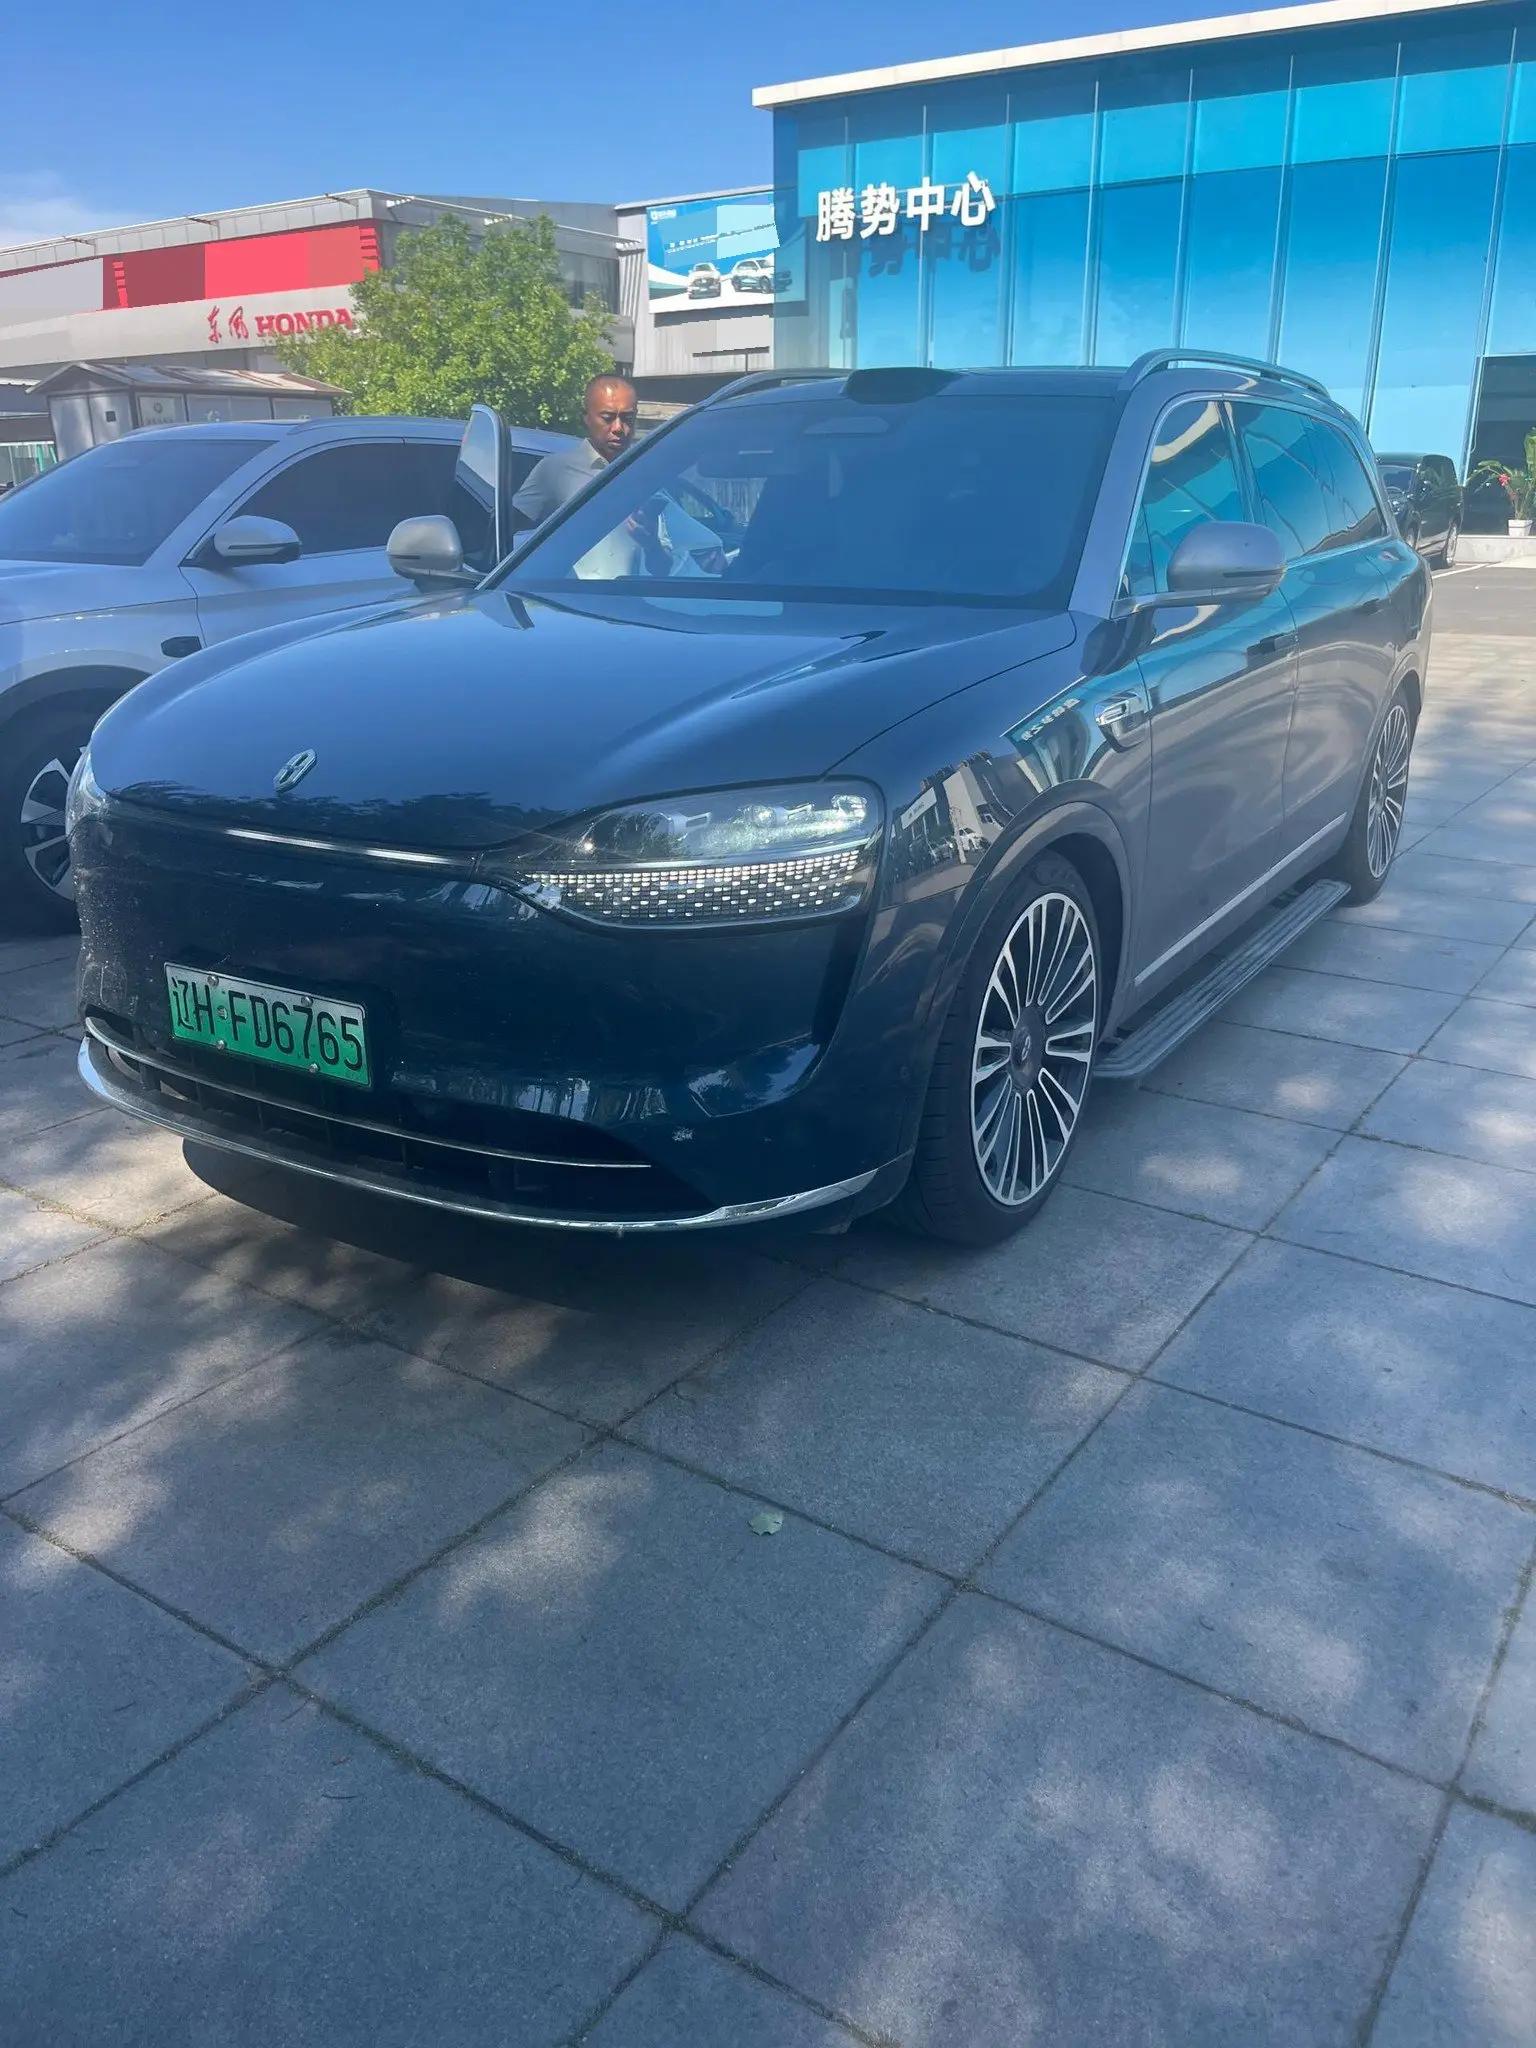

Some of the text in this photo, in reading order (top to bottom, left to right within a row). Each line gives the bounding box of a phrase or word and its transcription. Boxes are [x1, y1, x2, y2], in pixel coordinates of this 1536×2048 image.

[816, 171, 996, 242] 腾势中心
[255, 308, 353, 338] HONDA
